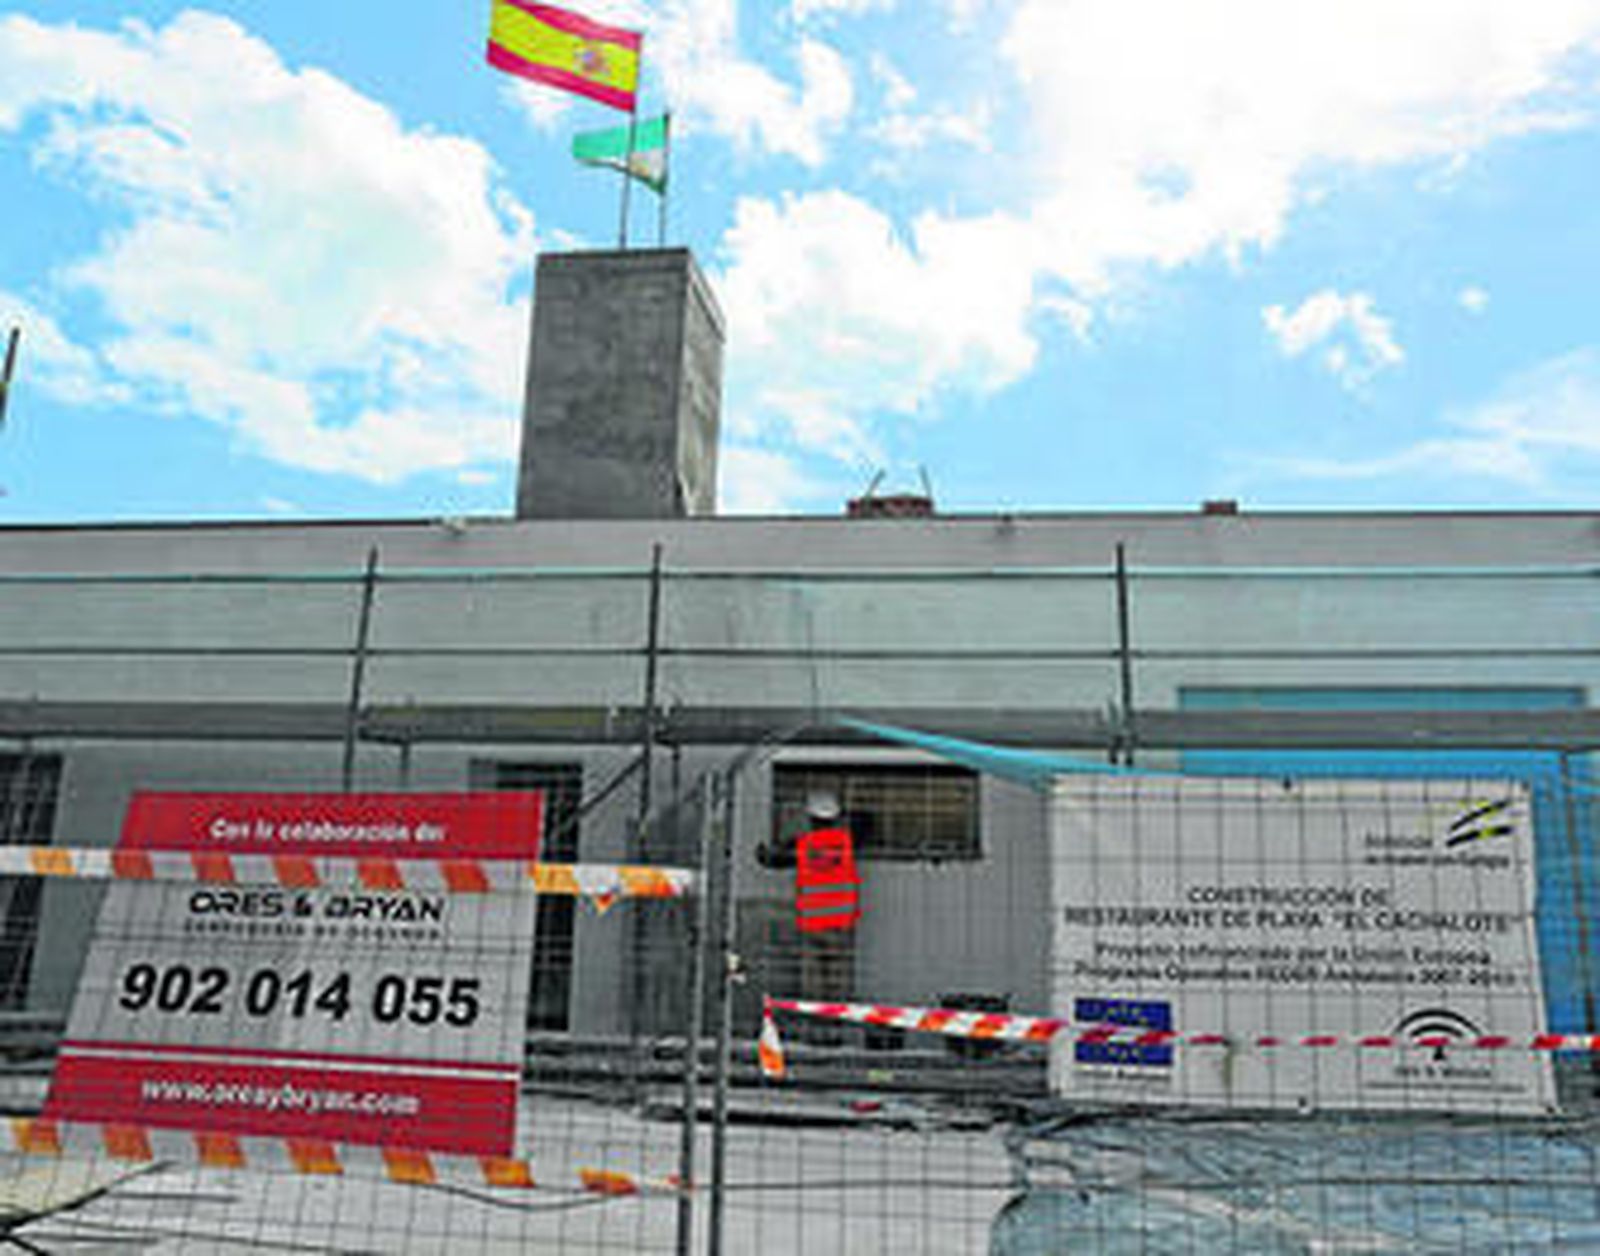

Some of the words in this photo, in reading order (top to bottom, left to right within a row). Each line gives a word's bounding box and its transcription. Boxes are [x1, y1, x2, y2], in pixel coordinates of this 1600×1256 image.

[209, 818, 250, 839] Con
[254, 819, 274, 840] la
[188, 890, 284, 918] ORES
[324, 895, 446, 922] BRYAN
[119, 963, 230, 1014] 902
[246, 968, 352, 1021] 014
[372, 975, 481, 1027] 055
